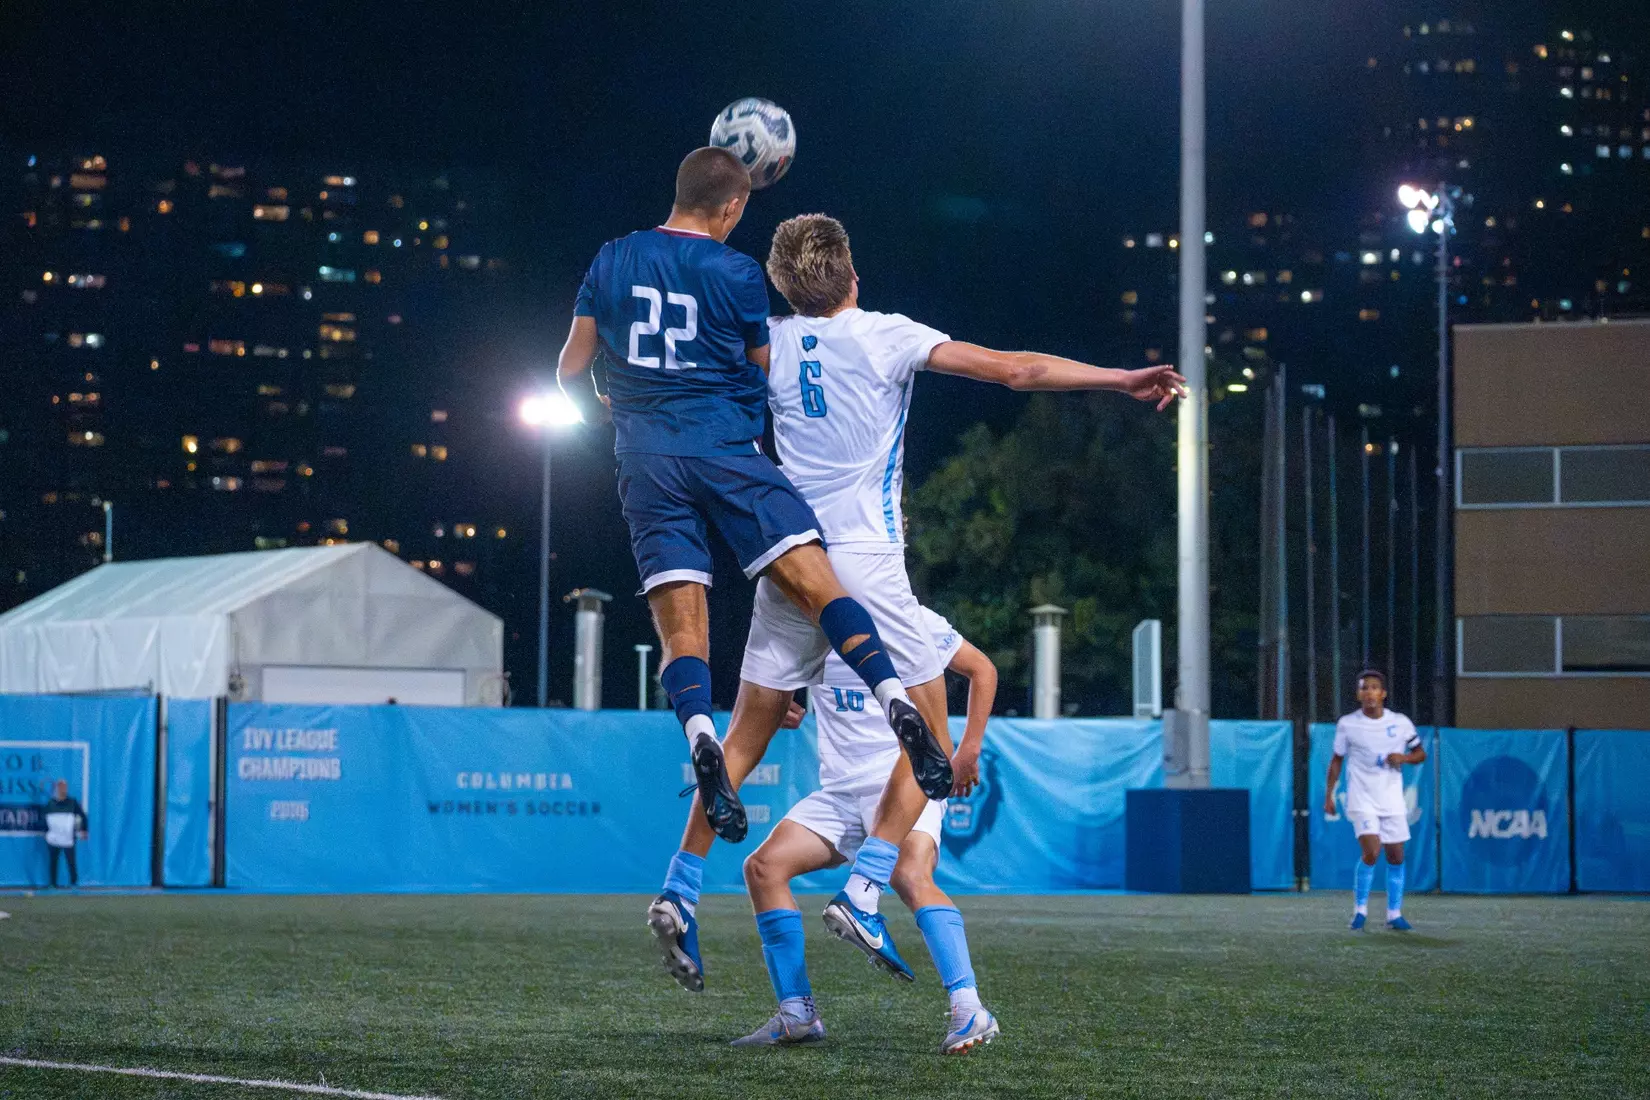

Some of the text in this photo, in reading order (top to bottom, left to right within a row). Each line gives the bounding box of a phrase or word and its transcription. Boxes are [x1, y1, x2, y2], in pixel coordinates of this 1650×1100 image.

[627, 285, 698, 370] 22
[799, 360, 827, 418] 6
[243, 728, 338, 751] IVY LEAGUE
[238, 757, 342, 780] CHAMPIONS
[456, 772, 573, 790] COLUMBIA
[427, 801, 602, 817] WOMEN'S SOCCER
[1468, 809, 1548, 840] NCAA
